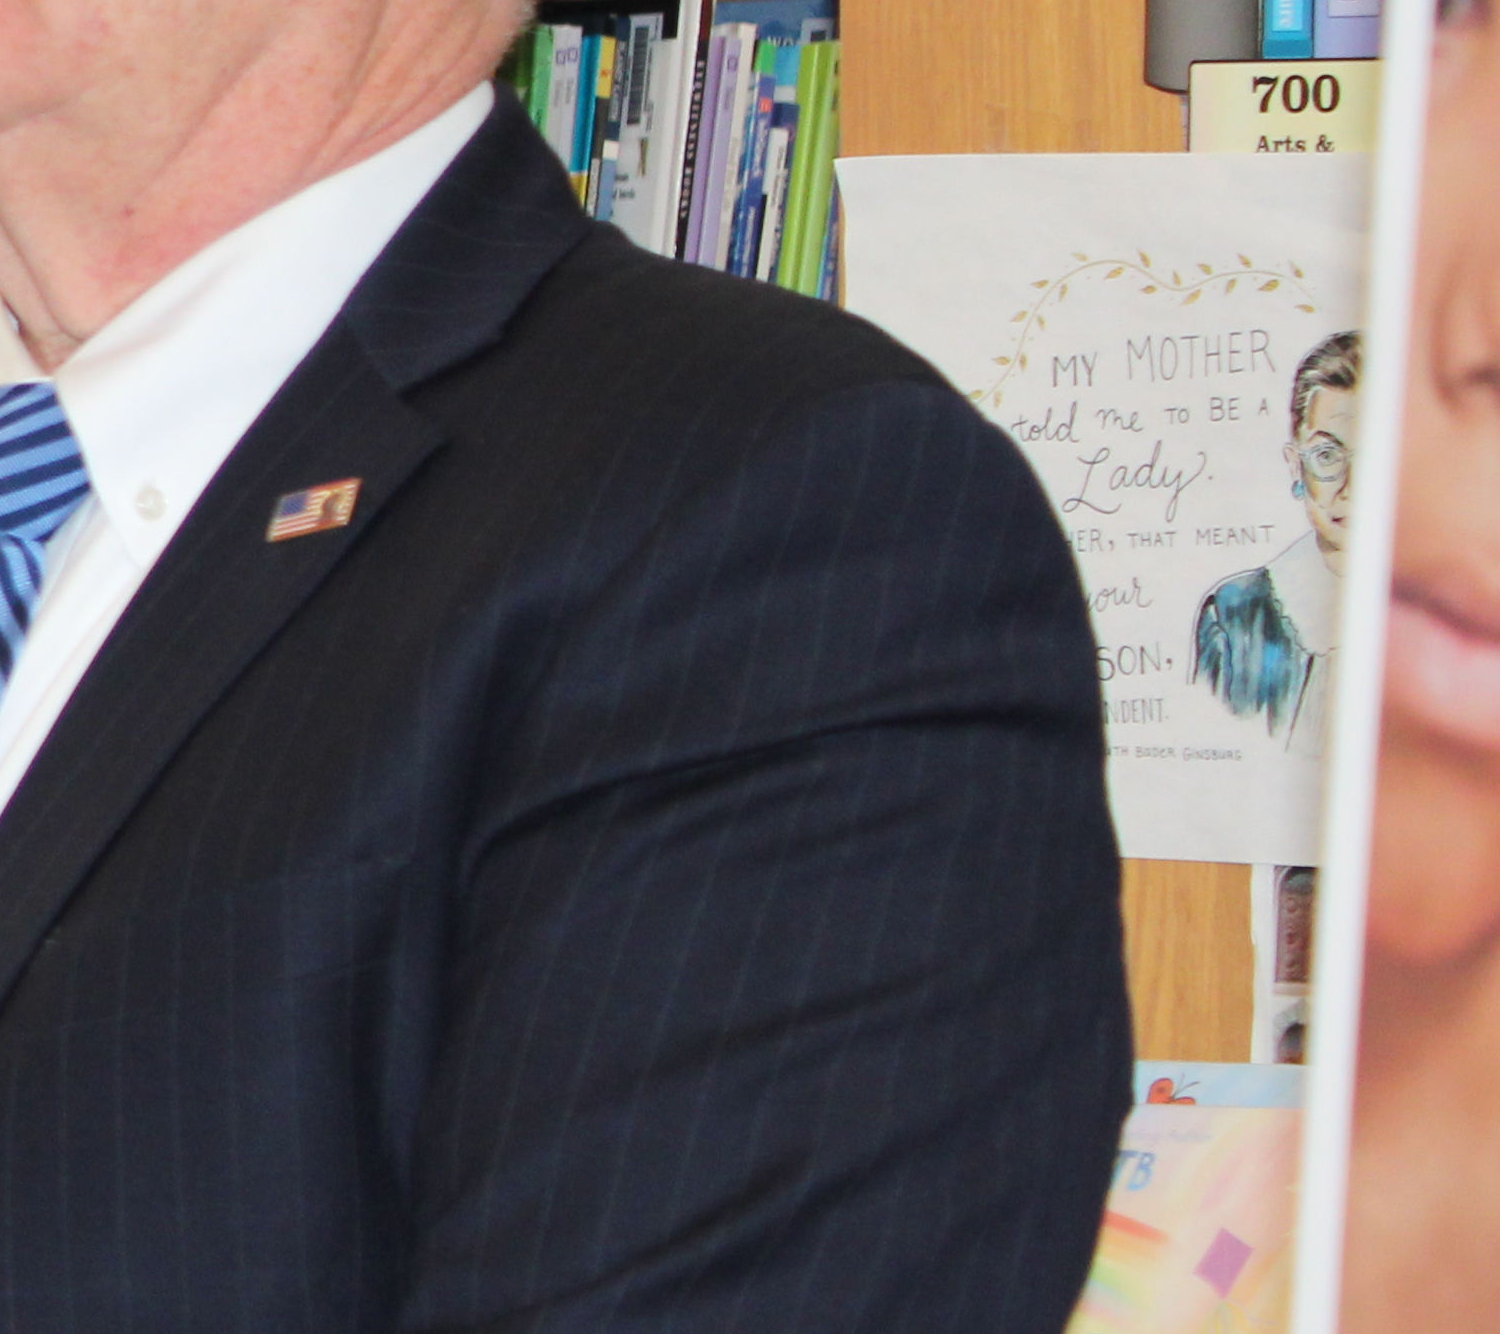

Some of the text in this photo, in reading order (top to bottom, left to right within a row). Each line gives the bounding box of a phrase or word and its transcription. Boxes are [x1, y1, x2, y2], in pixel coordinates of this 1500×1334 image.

[1252, 74, 1340, 115] 700
[1052, 329, 1277, 389] MY MOTHER
[1011, 395, 1271, 447] told me TO BE A
[1062, 441, 1215, 522] Lady.
[1127, 524, 1276, 549] THAT MEANT
